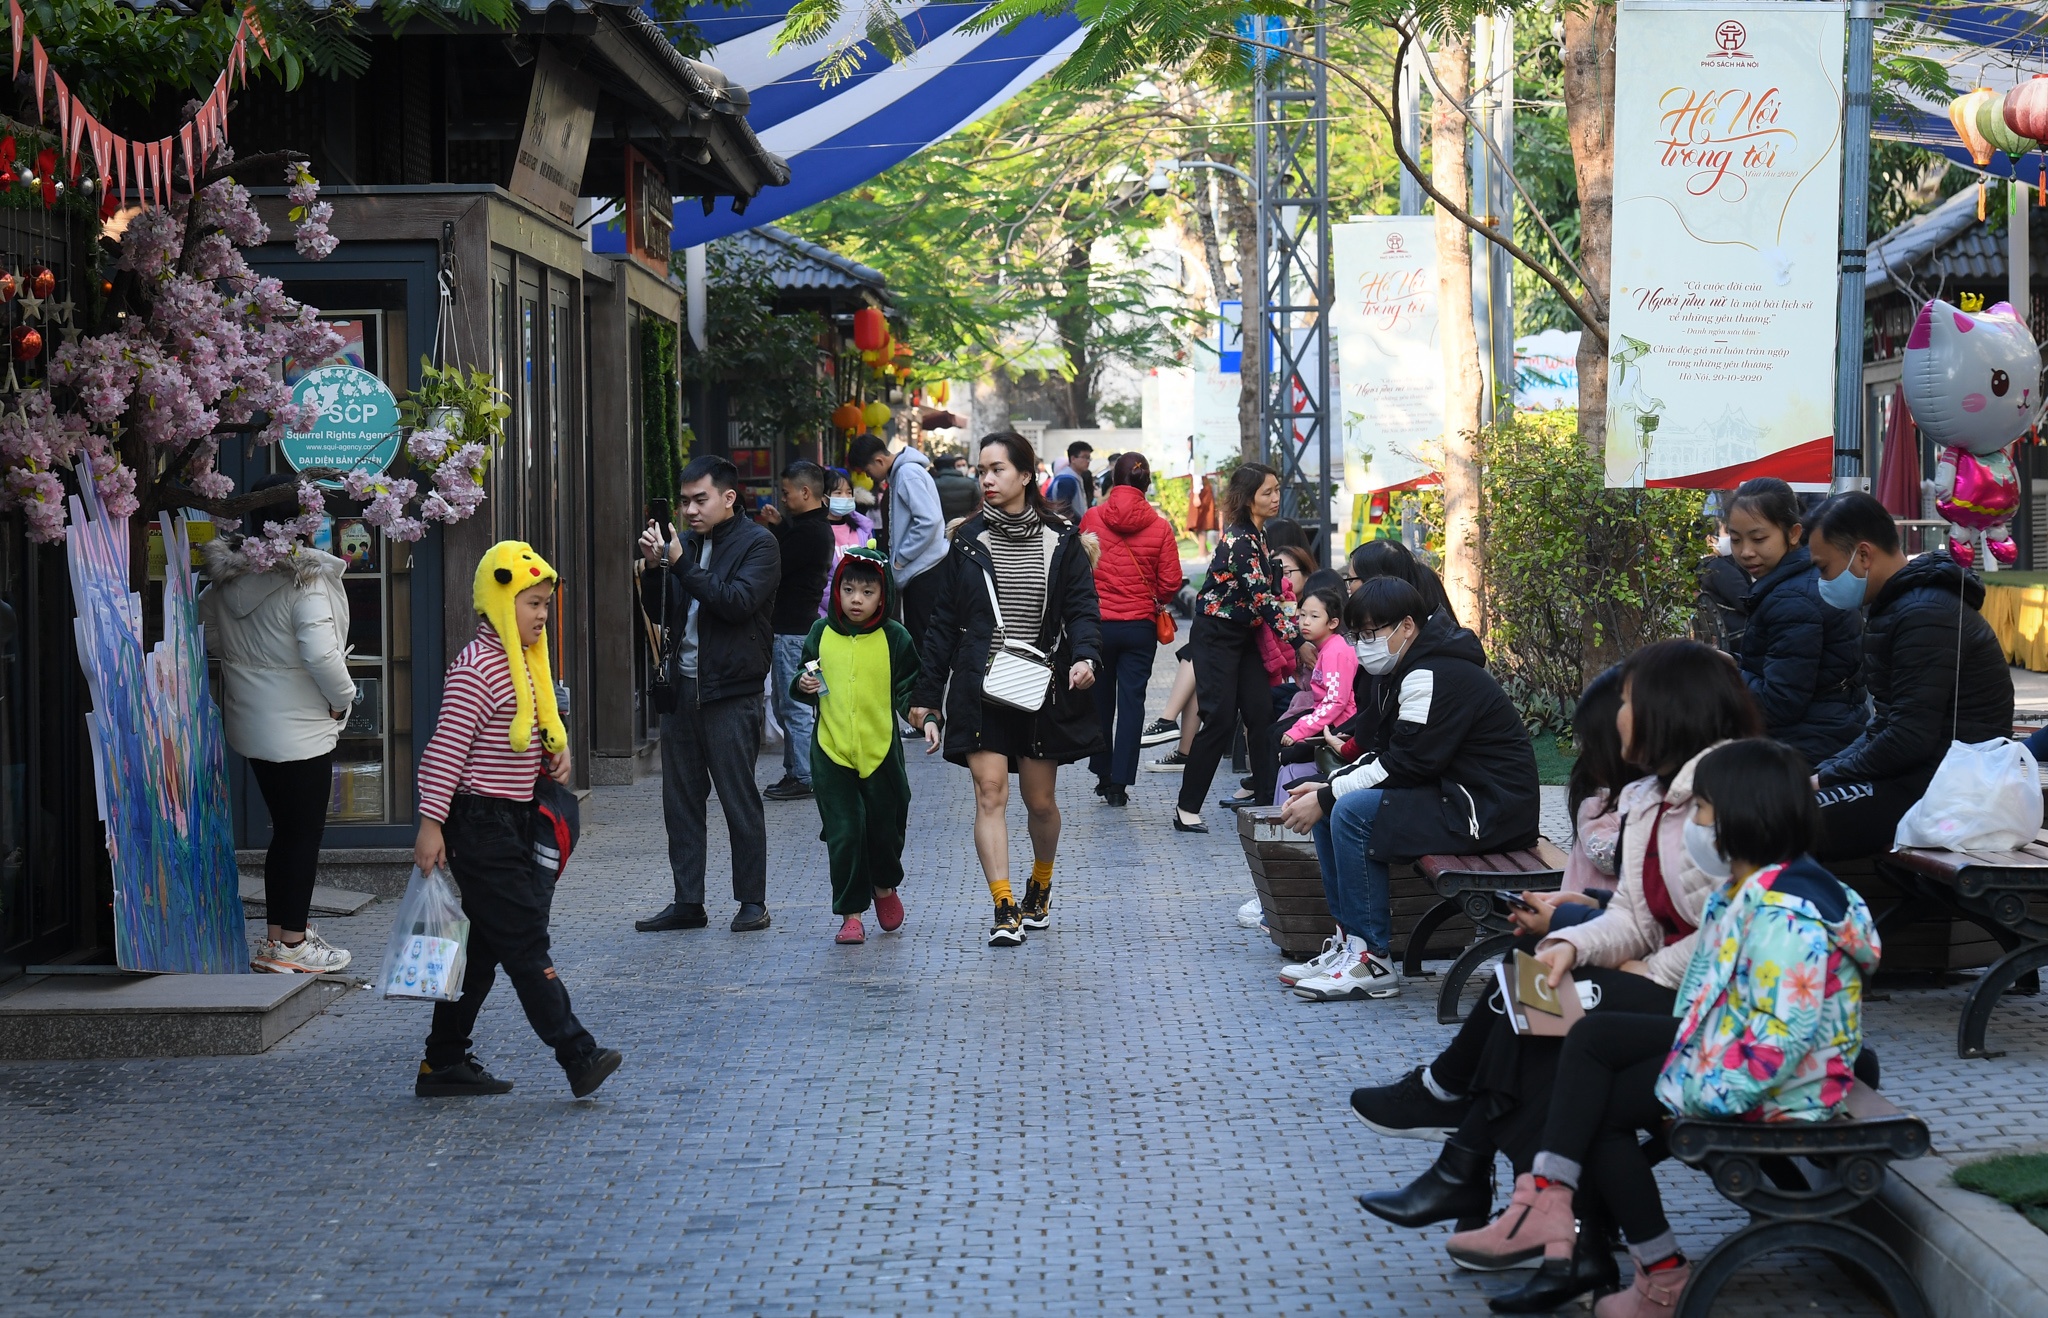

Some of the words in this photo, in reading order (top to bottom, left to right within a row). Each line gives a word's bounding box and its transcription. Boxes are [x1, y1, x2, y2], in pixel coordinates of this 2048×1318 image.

[1700, 60, 1716, 68] PHỐ
[1716, 60, 1735, 68] SÁCH
[1659, 86, 1718, 144] Hà
[1716, 87, 1782, 135] Nội
[1742, 141, 1780, 169] tôi
[1743, 170, 1761, 178] Mùa
[1762, 170, 1776, 178] thu
[1777, 170, 1799, 178] 2020
[1703, 282, 1725, 293] cuộc
[1726, 282, 1743, 291] đời
[1632, 287, 1681, 313] Người
[1680, 292, 1706, 310] phụ
[1709, 294, 1728, 308] nữ
[1730, 298, 1741, 308] là
[1742, 299, 1761, 309] một
[1763, 299, 1780, 309] bài
[1782, 299, 1799, 311] lịch
[1801, 300, 1814, 309] sử
[1669, 312, 1681, 322] về
[1681, 312, 1714, 324] những
[1714, 313, 1733, 325] yêu
[1652, 345, 1676, 355] Chúc
[1676, 345, 1692, 357] độc
[1709, 346, 1723, 355] nữ
[1724, 346, 1744, 355] luôn
[1746, 347, 1765, 356] tràn
[1767, 347, 1790, 358] ngập
[1667, 359, 1692, 369] trong
[1693, 359, 1722, 370] những
[1722, 360, 1740, 371] yêu
[1741, 360, 1774, 370] thương.
[1678, 372, 1693, 381] Hà
[1712, 373, 1763, 382] 20-10-2020
[328, 404, 378, 424] SCP
[286, 430, 323, 441] Squirrel
[326, 430, 357, 441] Rights
[358, 430, 395, 441] Agency
[306, 444, 378, 452] www.squi-agency.com
[299, 456, 313, 466] ĐẠI
[314, 455, 334, 466] DIỆN
[335, 455, 353, 465] BẢN
